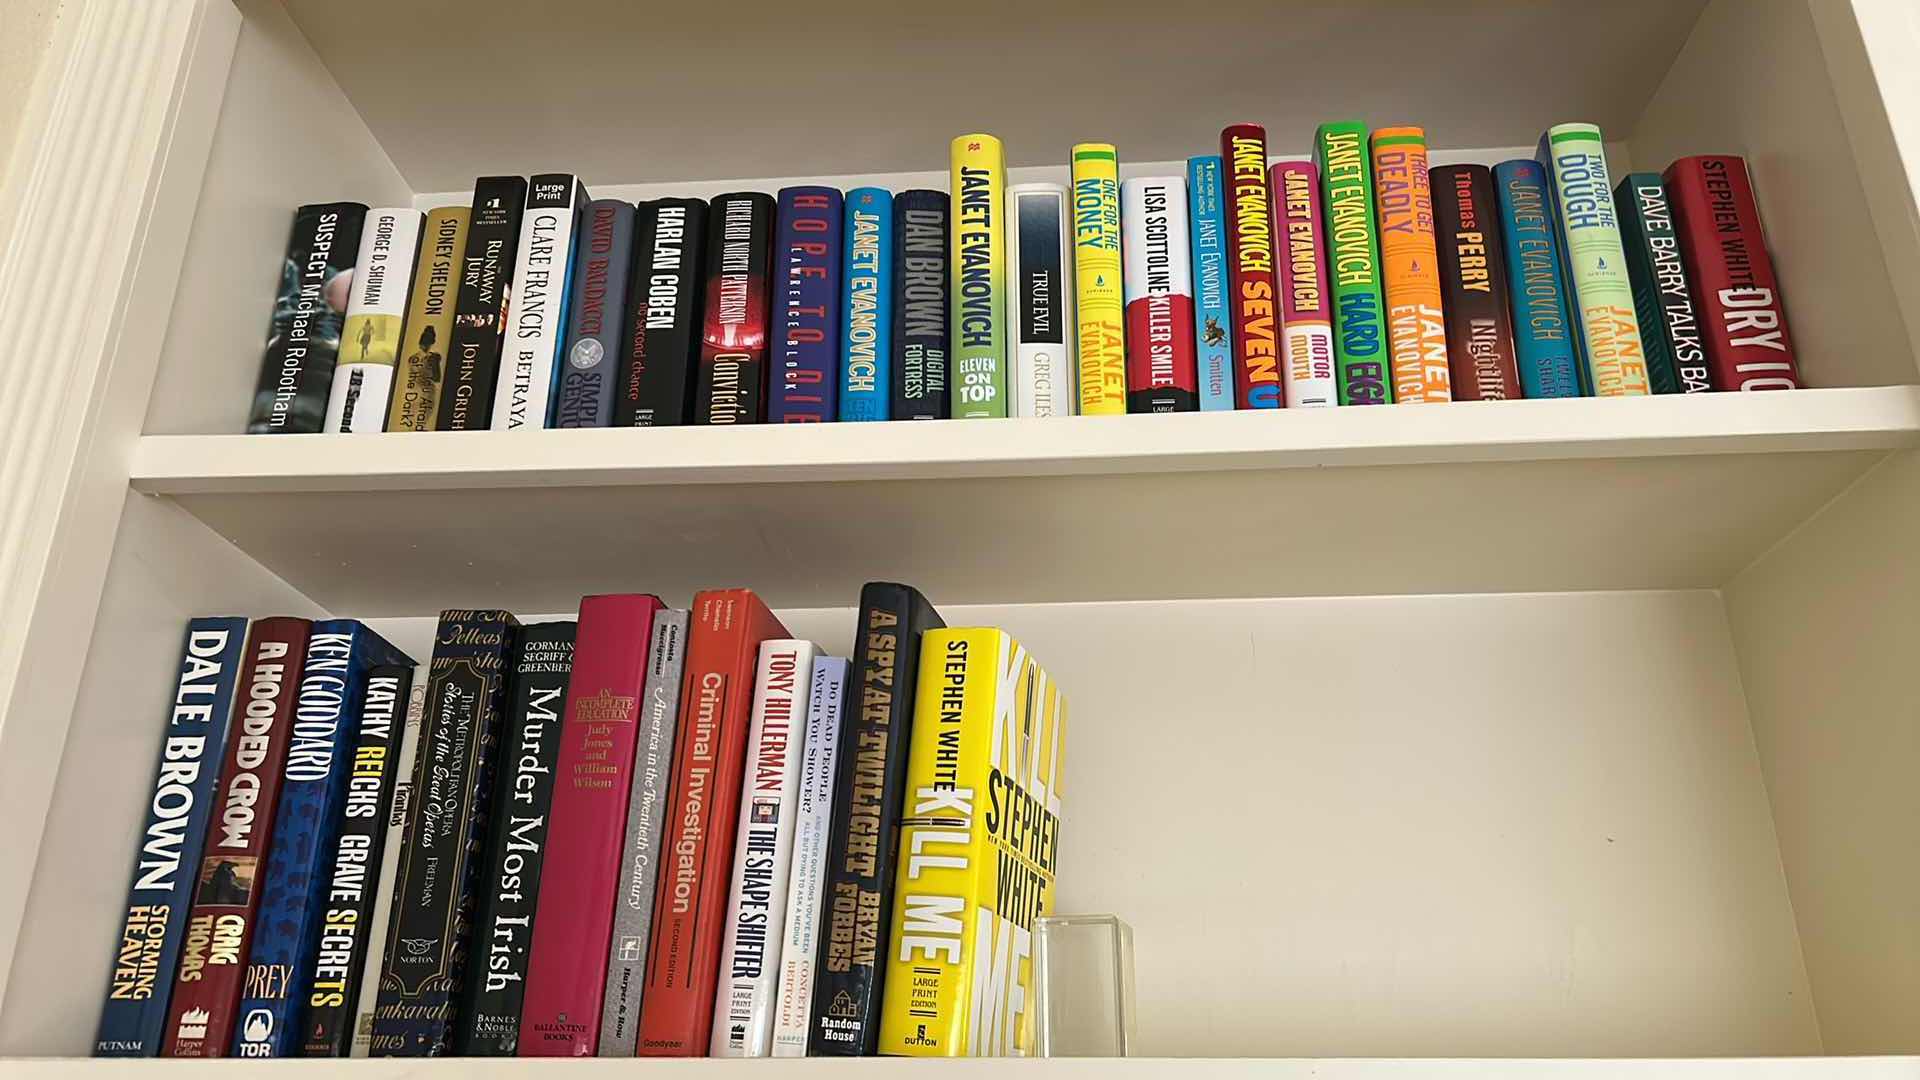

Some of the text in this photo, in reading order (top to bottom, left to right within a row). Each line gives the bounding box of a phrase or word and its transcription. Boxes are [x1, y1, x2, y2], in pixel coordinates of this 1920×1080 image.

[535, 183, 565, 193] Large
[536, 192, 561, 200] Print
[1075, 178, 1104, 249] MONEY
[1102, 179, 1118, 252] ONE FOR THE
[1232, 136, 1272, 273] JANET EVANOVICH
[1325, 132, 1373, 287] JANET EVANOVICH
[1376, 152, 1414, 233] DEADLY
[1557, 153, 1600, 230] DOUGH
[364, 215, 396, 305] GEORGE SHUMAN
[592, 207, 616, 254] DAVID
[718, 200, 752, 325] RICHARD NORTH PATTERSON
[790, 195, 829, 280] HOPE
[961, 166, 992, 348] JANET EVANOVICH
[1144, 186, 1170, 293] LISA SCOTTOLINE
[1284, 169, 1320, 312] JANET EVANOVICH
[1455, 172, 1491, 293] Thomas PERRY
[1509, 180, 1564, 341] JANET EVANOVICH
[1702, 161, 1757, 294] STEPHEN WHITE
[424, 219, 458, 316] SIDNEY SHELDON
[464, 257, 485, 288] JURY
[478, 240, 503, 304] RUNAWAY
[646, 207, 686, 329] HARLAN COBEN
[905, 210, 944, 336] DAN BROWN
[1199, 218, 1222, 309] JANET EVANOVICH
[1637, 186, 1704, 363] DAVE BARRY TALKS
[270, 213, 338, 427] SUSPECT Michael Robotham
[508, 215, 557, 430] CLARE FRANCIS BETRAYA
[632, 302, 649, 358] no second
[785, 247, 802, 390] LAWRENCE BLOCK
[848, 210, 880, 392] JANET EVANOVICH
[1242, 280, 1279, 383] SEVEN
[1339, 293, 1380, 357] HARD
[1717, 288, 1786, 353] DRY
[459, 343, 480, 381] JOHN
[905, 344, 923, 399] FORTRESS
[926, 349, 944, 393] DIGITAL
[960, 357, 996, 373] ELEVEN
[1034, 352, 1050, 389] GREG
[1080, 321, 1103, 406] EVANOVICH
[1100, 320, 1124, 404] JANET
[1149, 298, 1174, 386] KILLER SMILE
[1290, 335, 1312, 381] MOUTH
[1310, 334, 1331, 380] MOTOR
[1418, 304, 1451, 403] JANET
[1585, 306, 1618, 397] EVANOVICH
[1610, 305, 1649, 396] JANET
[407, 369, 421, 389] the
[960, 384, 996, 403] TOP
[964, 373, 991, 384] ON
[1153, 405, 1175, 413] LARGE
[523, 652, 567, 662] SEGRIFF
[525, 641, 575, 651] GORMAN
[285, 632, 353, 782] KEN GODDARD
[360, 677, 399, 740] KATHY
[586, 723, 612, 737] Judy
[755, 650, 797, 792] TONY HILLERMAN
[802, 668, 826, 814] WATCH YOU SHOWER?
[818, 681, 839, 803] DO DEAD PEOPLE
[933, 640, 969, 793] STEPHEN WHITE
[134, 630, 230, 891] DALE BROWN
[217, 664, 285, 849] HOODED CROW
[435, 742, 450, 762] the
[574, 762, 617, 774] William
[583, 738, 613, 751] Jones
[585, 749, 607, 760] and
[845, 632, 897, 878] SPY TWILIGHT
[345, 746, 387, 818] REICHS
[573, 778, 612, 788] Wilson
[672, 673, 722, 913] Criminal Investigation
[329, 834, 371, 903] GRAVE
[485, 687, 563, 993] Murder Most Irish
[628, 767, 658, 910] the Century
[807, 859, 818, 901] QUESTIONS
[110, 905, 151, 1000] HEAVEN
[131, 905, 170, 1001] STORMING
[180, 914, 214, 983] THOMAS
[208, 914, 246, 966] CRAIG
[732, 858, 774, 979] SHAPE SHIFTER
[827, 881, 858, 973] FORBES
[852, 890, 881, 966] BRYAN
[899, 895, 966, 965] ME
[242, 964, 294, 1000] PREY
[311, 908, 358, 1008] SECRETS
[911, 989, 938, 998] PRINT
[912, 978, 939, 987] LARGE
[477, 1014, 517, 1023] BARNES
[534, 1023, 588, 1032] BALLANTINE
[615, 967, 631, 1039] Harper Row
[733, 991, 752, 999] LARGE
[796, 960, 809, 1028] CONCETTA
[821, 1016, 861, 1030] Random
[910, 1000, 937, 1008] EDITION
[98, 1041, 143, 1051] PUTNAM
[176, 1040, 203, 1050] Harper
[240, 1043, 271, 1057] TOR
[543, 1033, 574, 1041] BOOKS
[643, 1040, 682, 1049] Goodyear
[824, 1030, 854, 1042] House
[904, 1037, 937, 1047] DUTTON
